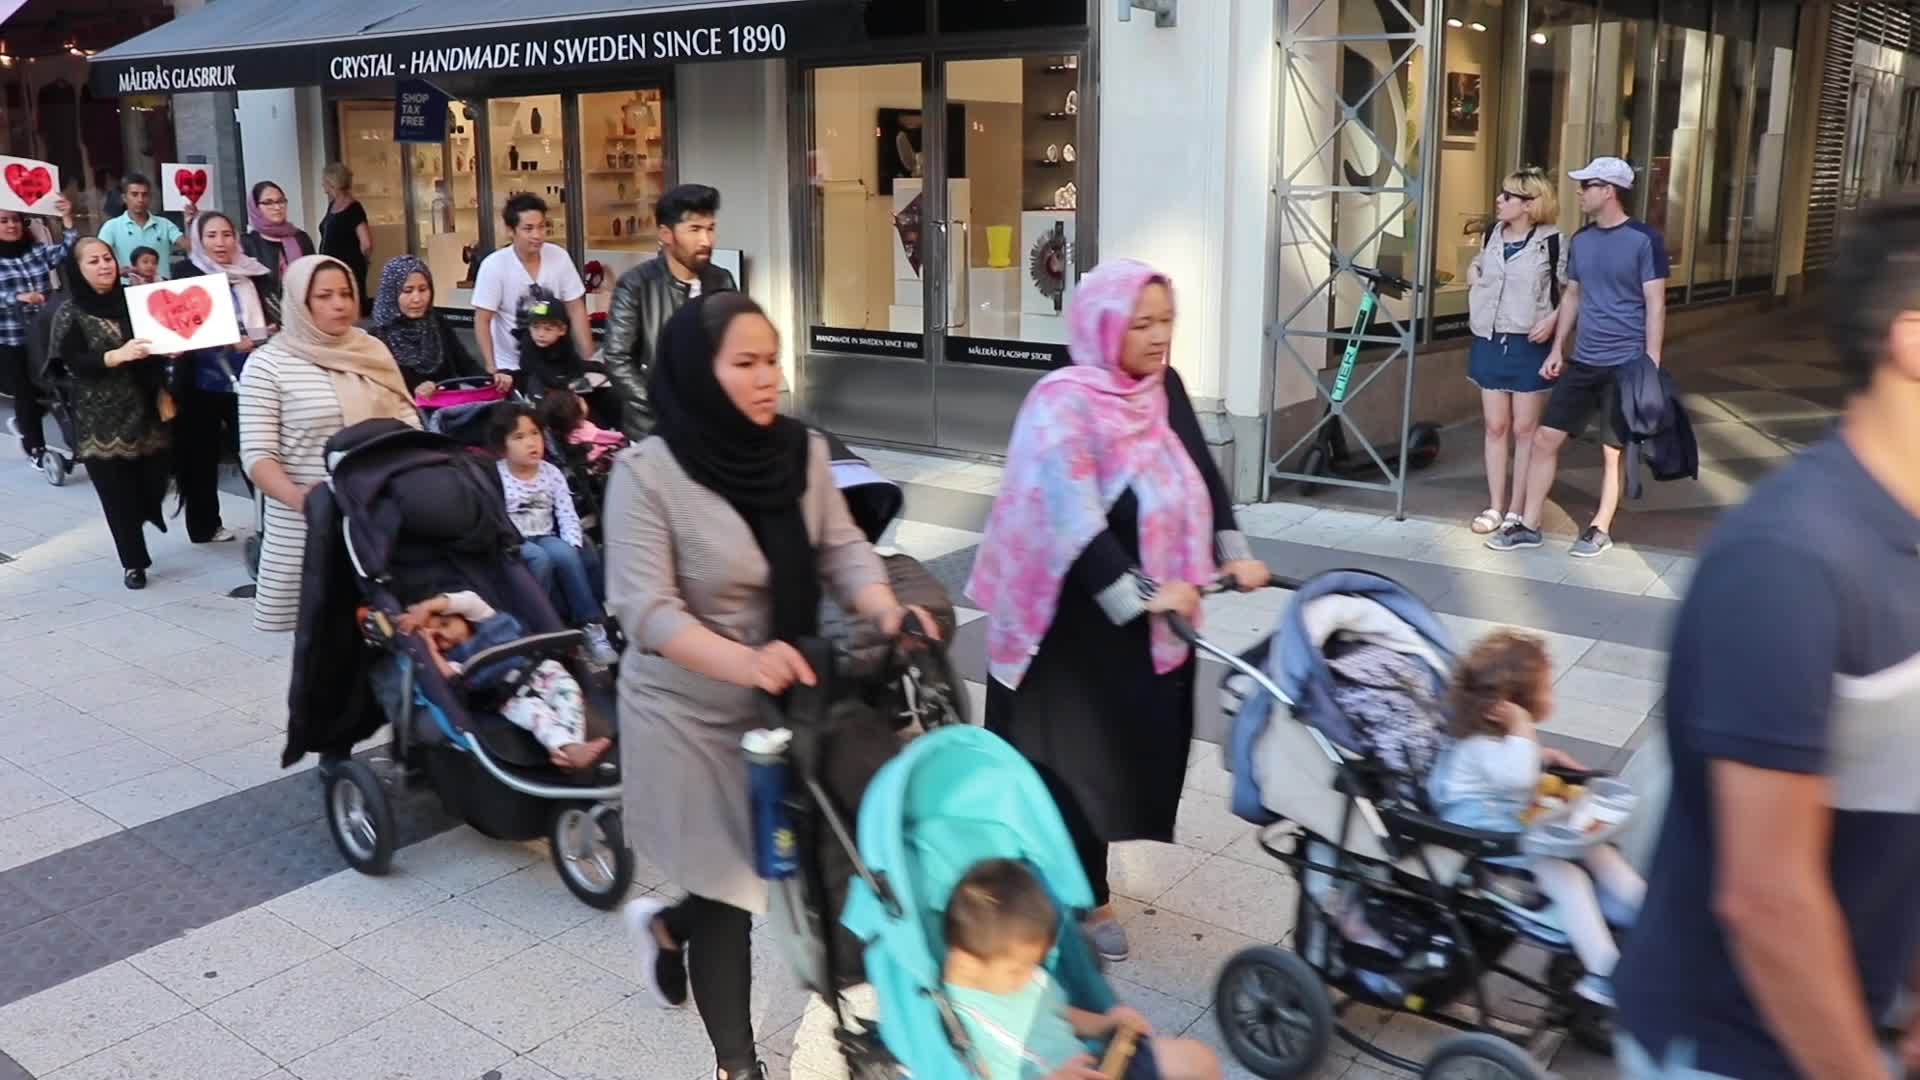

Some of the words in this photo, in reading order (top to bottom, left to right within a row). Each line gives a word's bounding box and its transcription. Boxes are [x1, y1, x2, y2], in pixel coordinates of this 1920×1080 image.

[330, 53, 395, 80] CRYSTAL
[411, 43, 520, 75] HANDMADE
[525, 41, 547, 67] IN
[553, 33, 646, 65] SWEDEN
[654, 27, 722, 58] SINCE
[729, 23, 786, 53] 1890
[119, 64, 170, 92] MÅLERÅS
[172, 65, 236, 88] GLASBRUK
[402, 93, 430, 104] SHOP
[402, 104, 420, 115] TAX
[401, 115, 425, 127] FREE
[816, 334, 850, 344] HANDMADE
[851, 337, 858, 345] IN
[859, 337, 883, 347] SWEDEN
[884, 340, 902, 349] SINCE
[968, 345, 998, 357] MÅLERÅS
[998, 350, 1030, 360] FLAGSHIP
[1031, 352, 1052, 361] STORE
